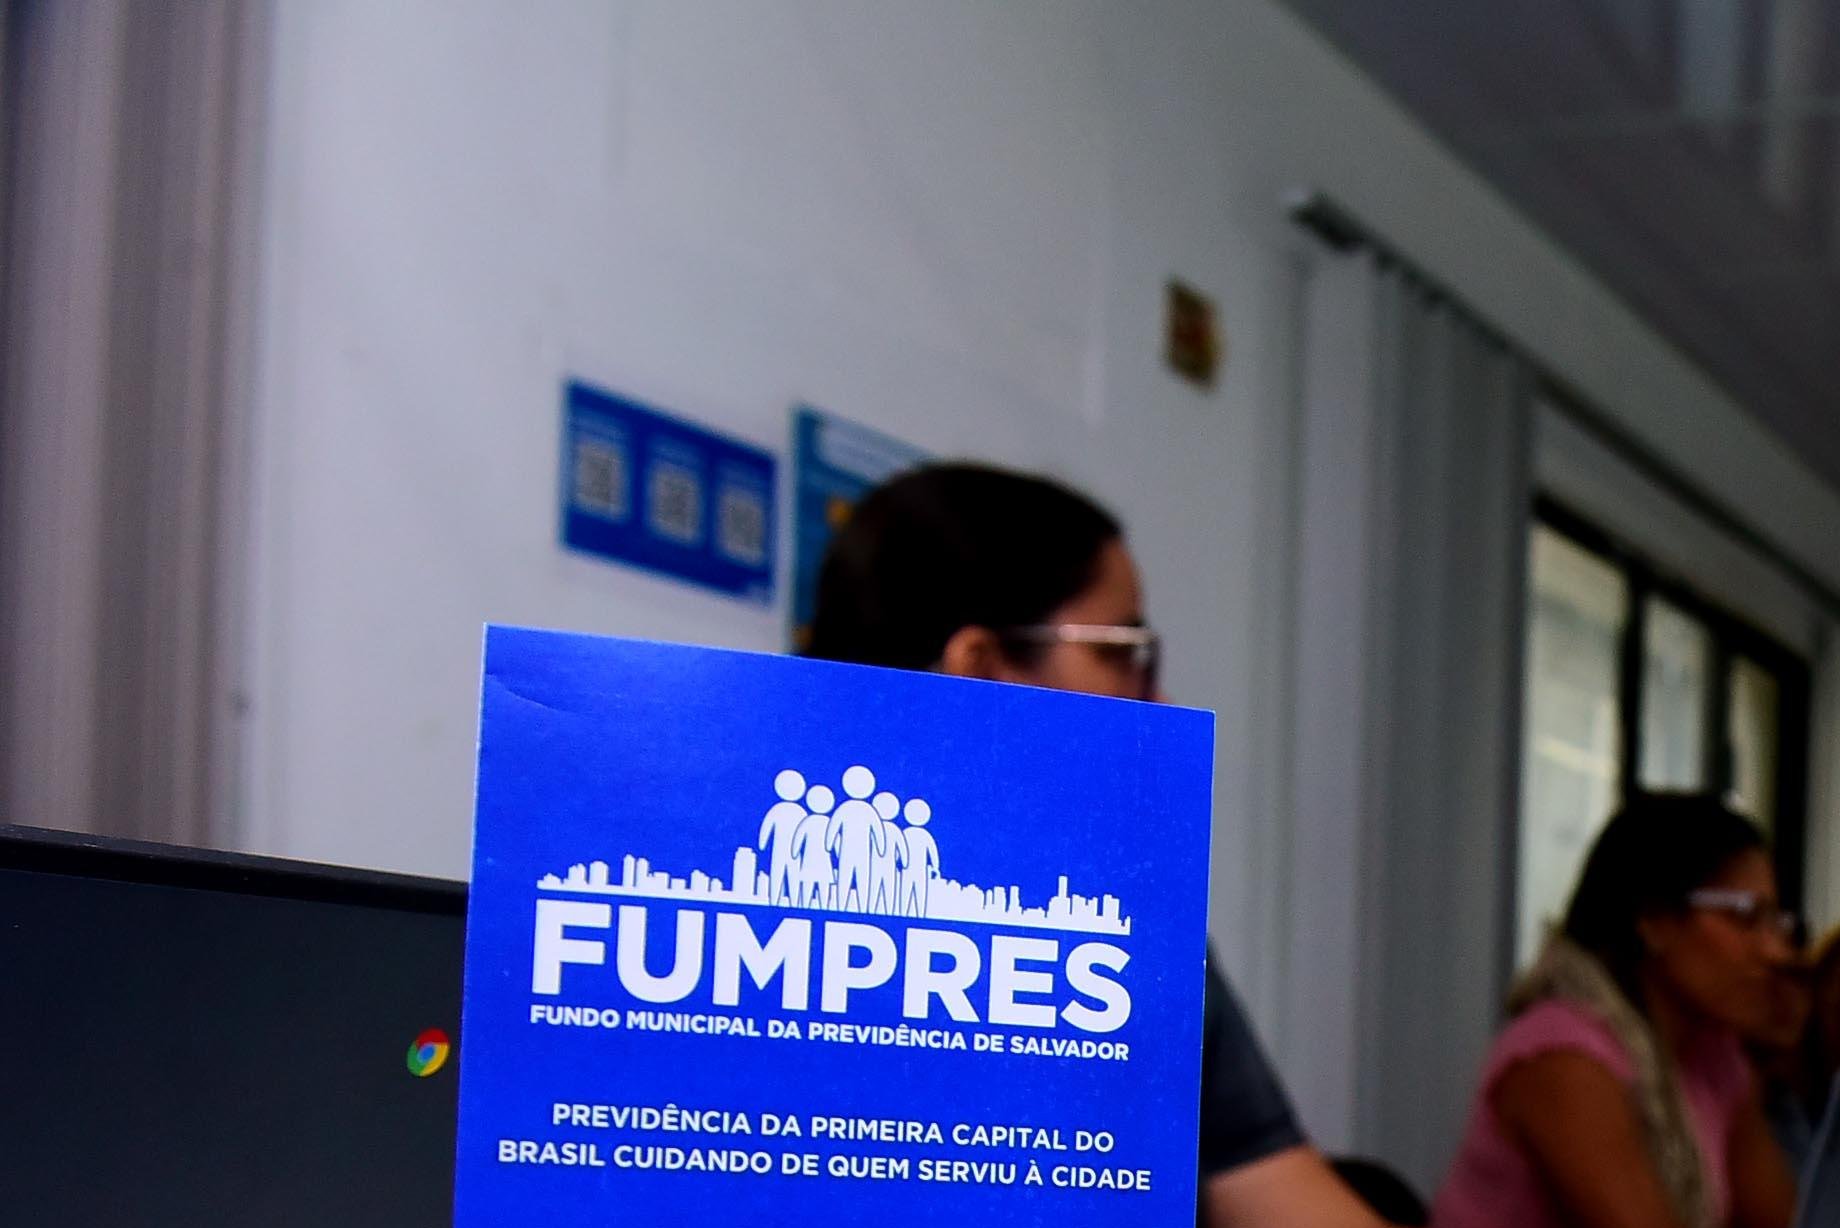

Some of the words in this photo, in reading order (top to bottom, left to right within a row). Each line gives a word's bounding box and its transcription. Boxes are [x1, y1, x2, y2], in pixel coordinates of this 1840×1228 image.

[531, 898, 1132, 1033] FUMPRES
[531, 1005, 620, 1028] FUNDO
[627, 1011, 761, 1036] MUNICIPAL
[768, 1020, 801, 1039] DA
[809, 1022, 966, 1049] PREVIDÊNCIA
[974, 1033, 1004, 1052] DE
[1010, 1036, 1128, 1060] SALVADOR
[553, 1104, 751, 1134] PREVIDÊNCIA
[761, 1114, 801, 1136] DA
[812, 1117, 943, 1143] PRIMEIRA
[953, 1124, 1067, 1150] CAPITAL
[1076, 1131, 1113, 1152] DO
[499, 1140, 605, 1166] BRASIL
[614, 1146, 772, 1173] CUIDANDO
[782, 1153, 819, 1175] DE
[828, 1156, 909, 1179] QUEM
[919, 1160, 1015, 1184] SERVIU
[1025, 1160, 1043, 1185] À
[1052, 1166, 1150, 1190] CIDADE
